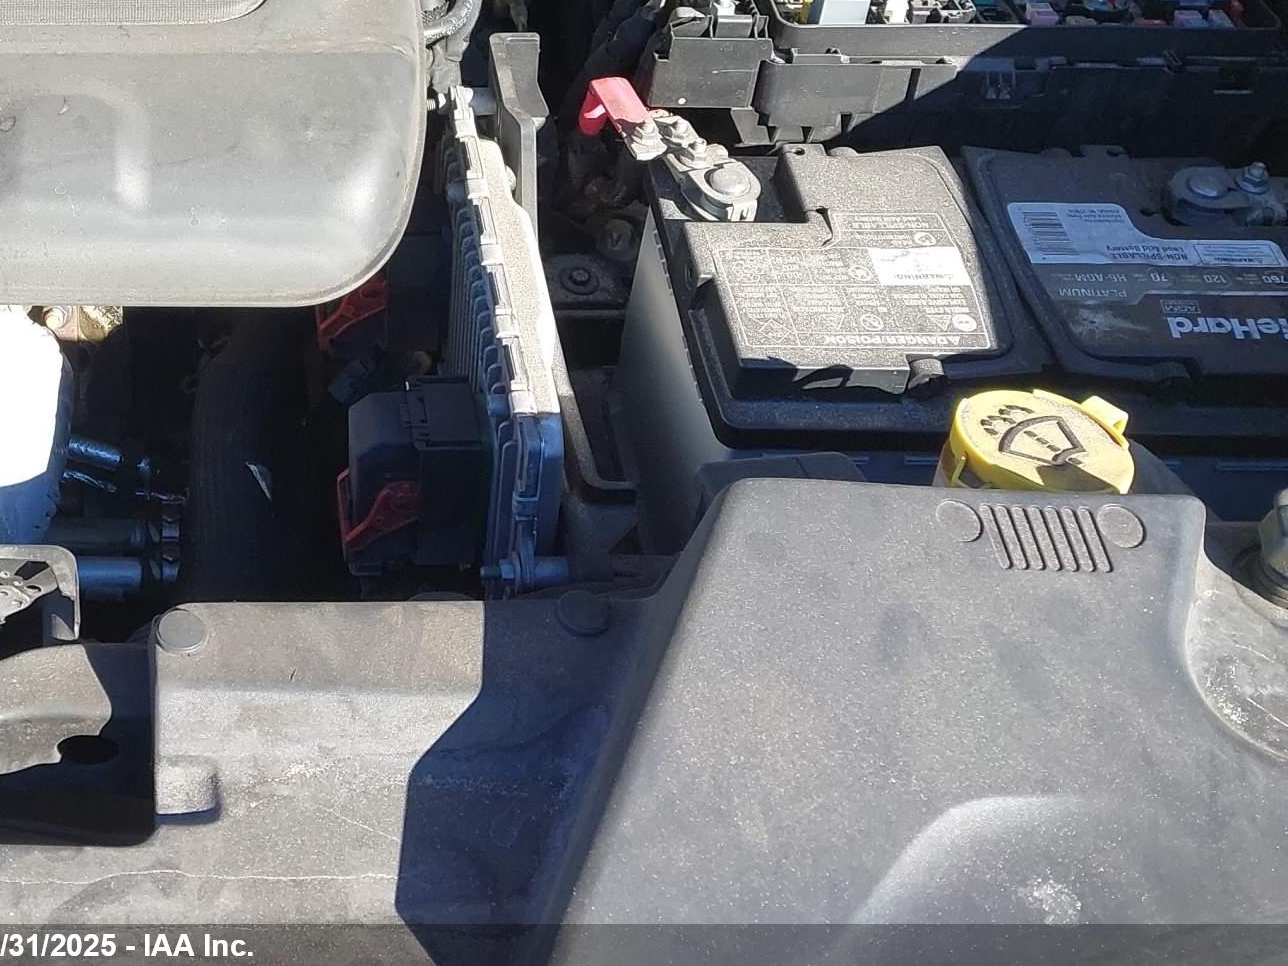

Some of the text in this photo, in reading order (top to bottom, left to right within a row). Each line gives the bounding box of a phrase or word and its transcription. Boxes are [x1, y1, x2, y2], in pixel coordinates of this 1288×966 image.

[1106, 244, 1139, 252] Battery
[1141, 244, 1159, 252] Acid
[1110, 252, 1188, 261] NON-SPILLABLE
[1150, 272, 1168, 282] 70
[1203, 274, 1226, 283] 120
[1058, 287, 1127, 298] PLATINUM
